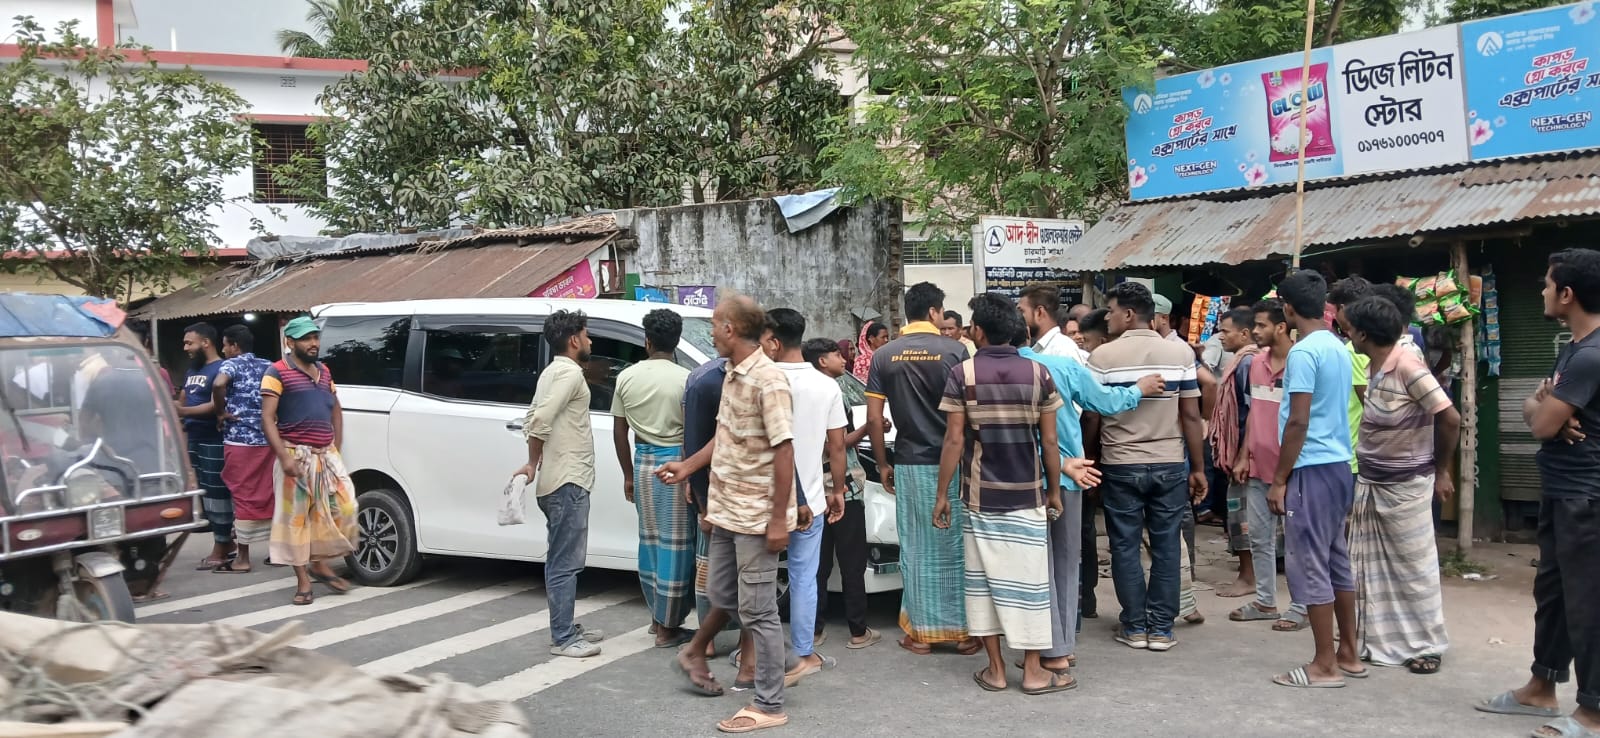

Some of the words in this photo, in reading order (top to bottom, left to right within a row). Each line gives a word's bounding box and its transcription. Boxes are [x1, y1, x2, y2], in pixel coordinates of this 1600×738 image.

[1532, 47, 1576, 67] কাপড়
[1341, 59, 1395, 94] ডিজে
[1398, 48, 1454, 86] লিটন
[1549, 58, 1588, 76] করবে
[1271, 83, 1323, 116] GLOW
[1174, 107, 1203, 124] কাপড়
[1365, 95, 1423, 127] স্টোর
[1531, 112, 1592, 126] NEXT-GEN
[1212, 125, 1238, 140] সাথে
[1538, 121, 1586, 132] TECHNOLOGY
[1358, 130, 1445, 152] ০১৭৬১০০০৭০৭
[1174, 161, 1217, 173] NEXT-GEN
[891, 354, 942, 362] Diamond
[185, 375, 207, 388] NIKE
